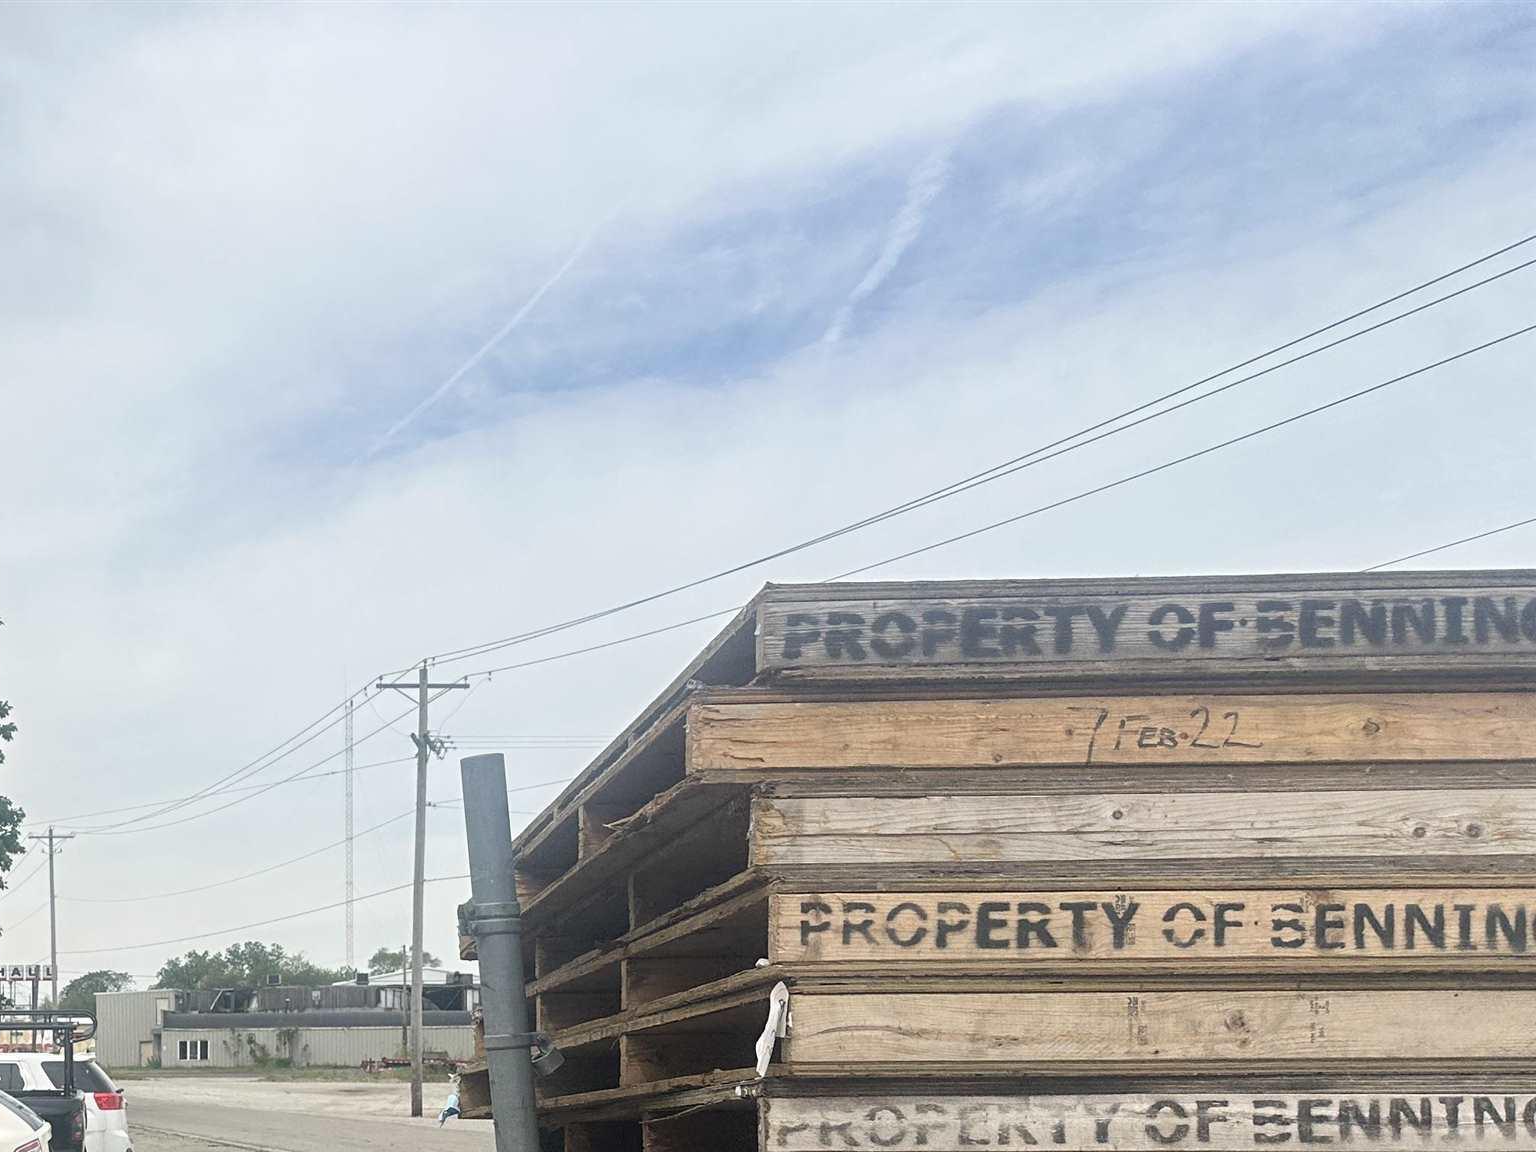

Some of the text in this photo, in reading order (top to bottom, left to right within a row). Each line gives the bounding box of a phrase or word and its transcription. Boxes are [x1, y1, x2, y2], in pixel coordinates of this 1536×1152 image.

[782, 604, 1129, 660] PROPERTY
[1148, 602, 1234, 652] OF
[1190, 705, 1264, 749] 22
[800, 901, 1140, 949] PROPERTY
[1161, 901, 1246, 949] OF
[1270, 902, 1536, 951] BENNIN
[777, 1103, 1121, 1146] PROPERTY
[1144, 1100, 1229, 1143] OF
